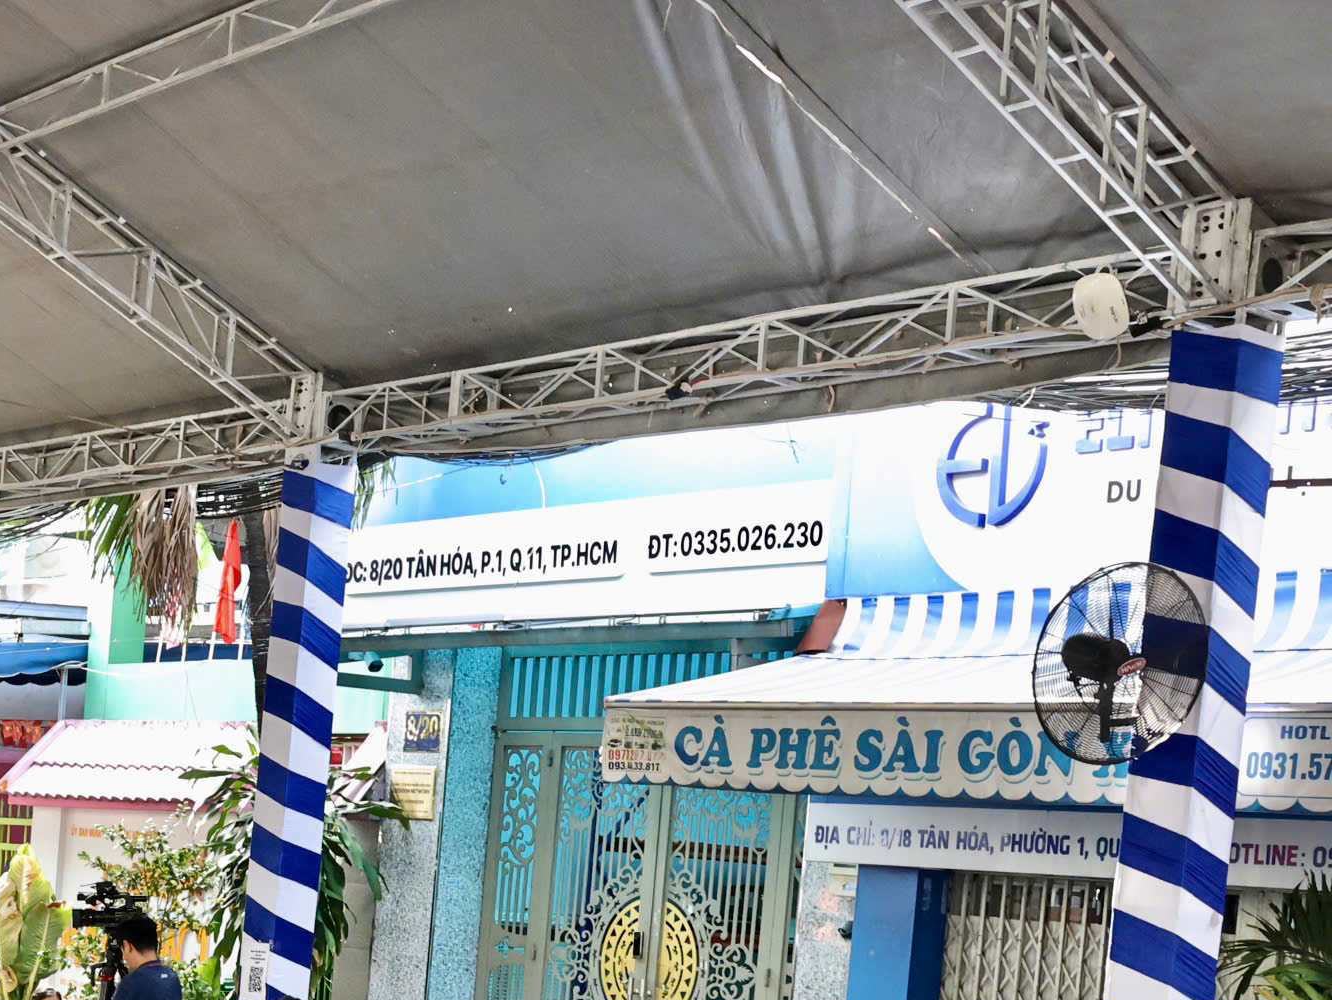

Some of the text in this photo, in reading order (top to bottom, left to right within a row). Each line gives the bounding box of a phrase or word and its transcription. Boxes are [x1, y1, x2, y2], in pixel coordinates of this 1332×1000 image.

[1107, 479, 1141, 503] DU
[369, 559, 403, 585] 8/20
[406, 549, 437, 578] TÂN
[440, 546, 478, 578] HÓA,
[550, 541, 618, 568] TP.HCM
[674, 714, 733, 771] CÀ
[747, 716, 841, 774] PHÊ
[853, 716, 945, 777] SÀI
[958, 717, 1074, 780] GÒN
[815, 825, 840, 850] ĐỊA
[918, 825, 950, 849] TÂN
[956, 826, 994, 854] HÓA,
[1000, 828, 1070, 855] PHƯỜNG
